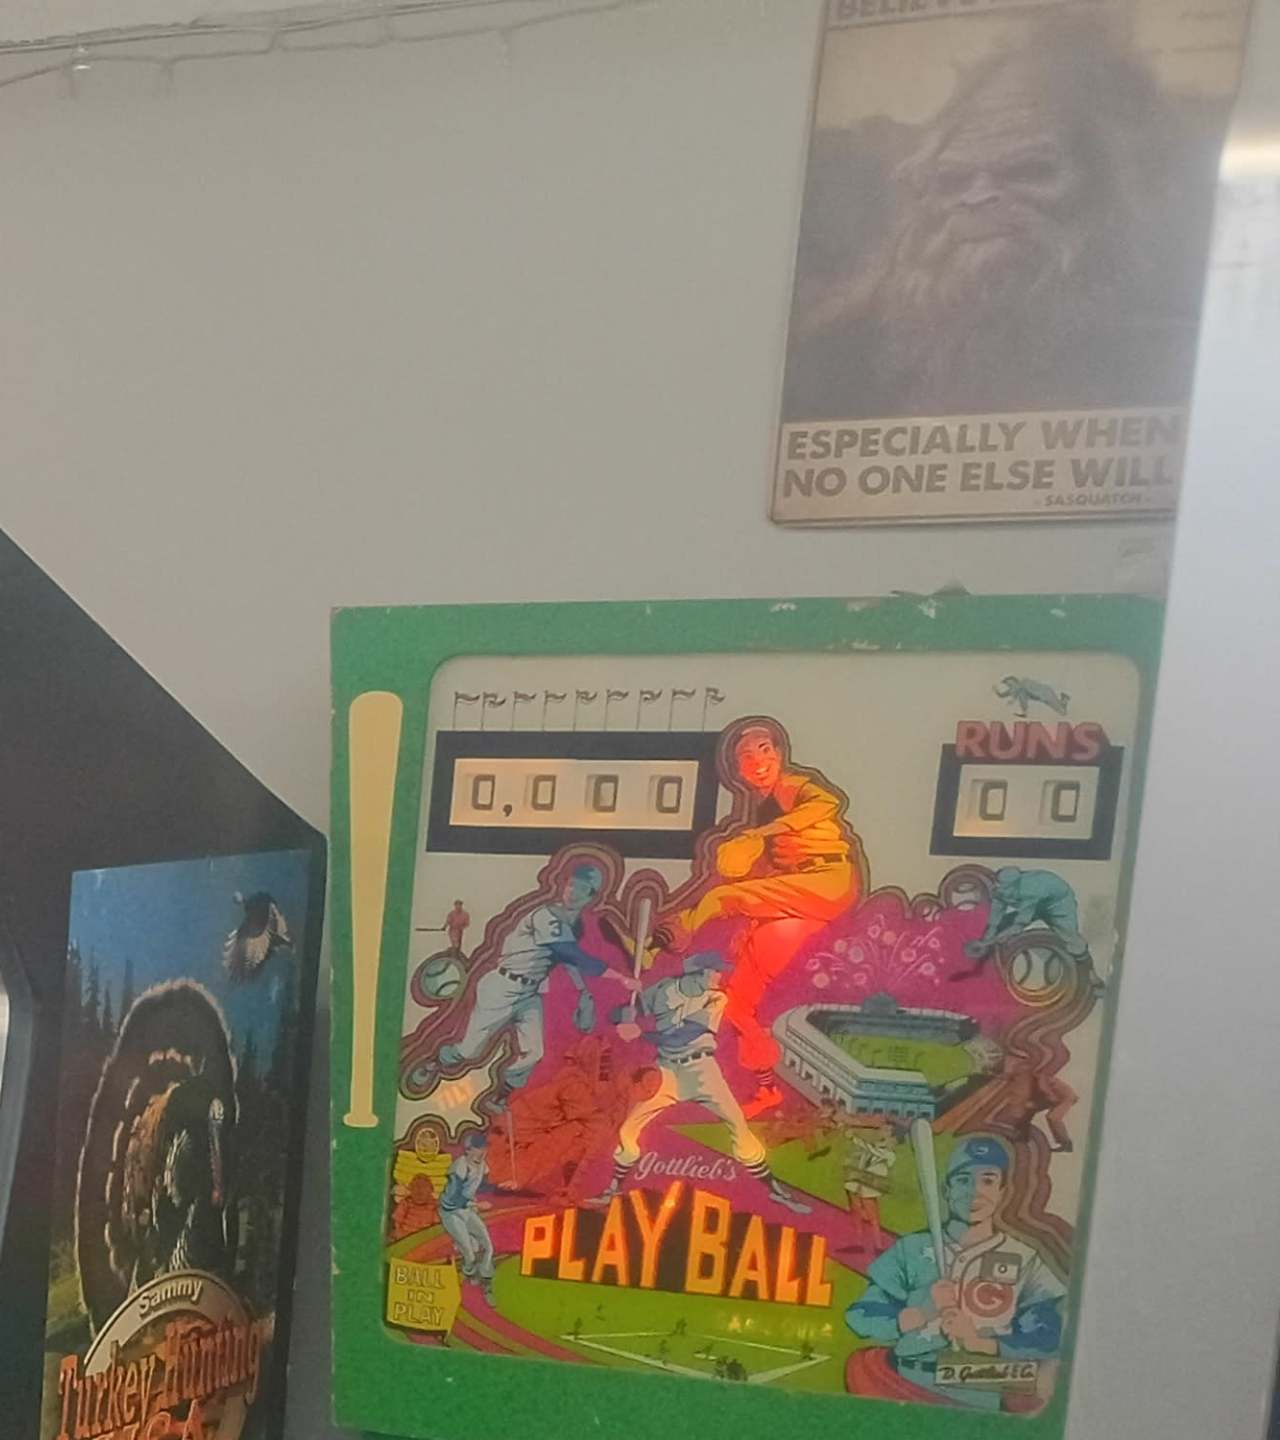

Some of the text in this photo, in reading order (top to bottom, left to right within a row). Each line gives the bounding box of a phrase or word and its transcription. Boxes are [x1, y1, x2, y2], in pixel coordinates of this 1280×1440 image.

[787, 413, 1181, 461] ESPECIALLY WHEN
[783, 455, 1174, 498] NO ONE ELSE WILL
[956, 720, 1108, 761] RUNS
[634, 1151, 737, 1181] Gottlieb's
[520, 1181, 833, 1308] PLAY BALL
[139, 1278, 202, 1317] Sammy
[396, 1266, 444, 1290] BALL
[407, 1289, 434, 1304] IN
[393, 1302, 442, 1327] PLAY
[164, 1317, 262, 1408] Hunting
